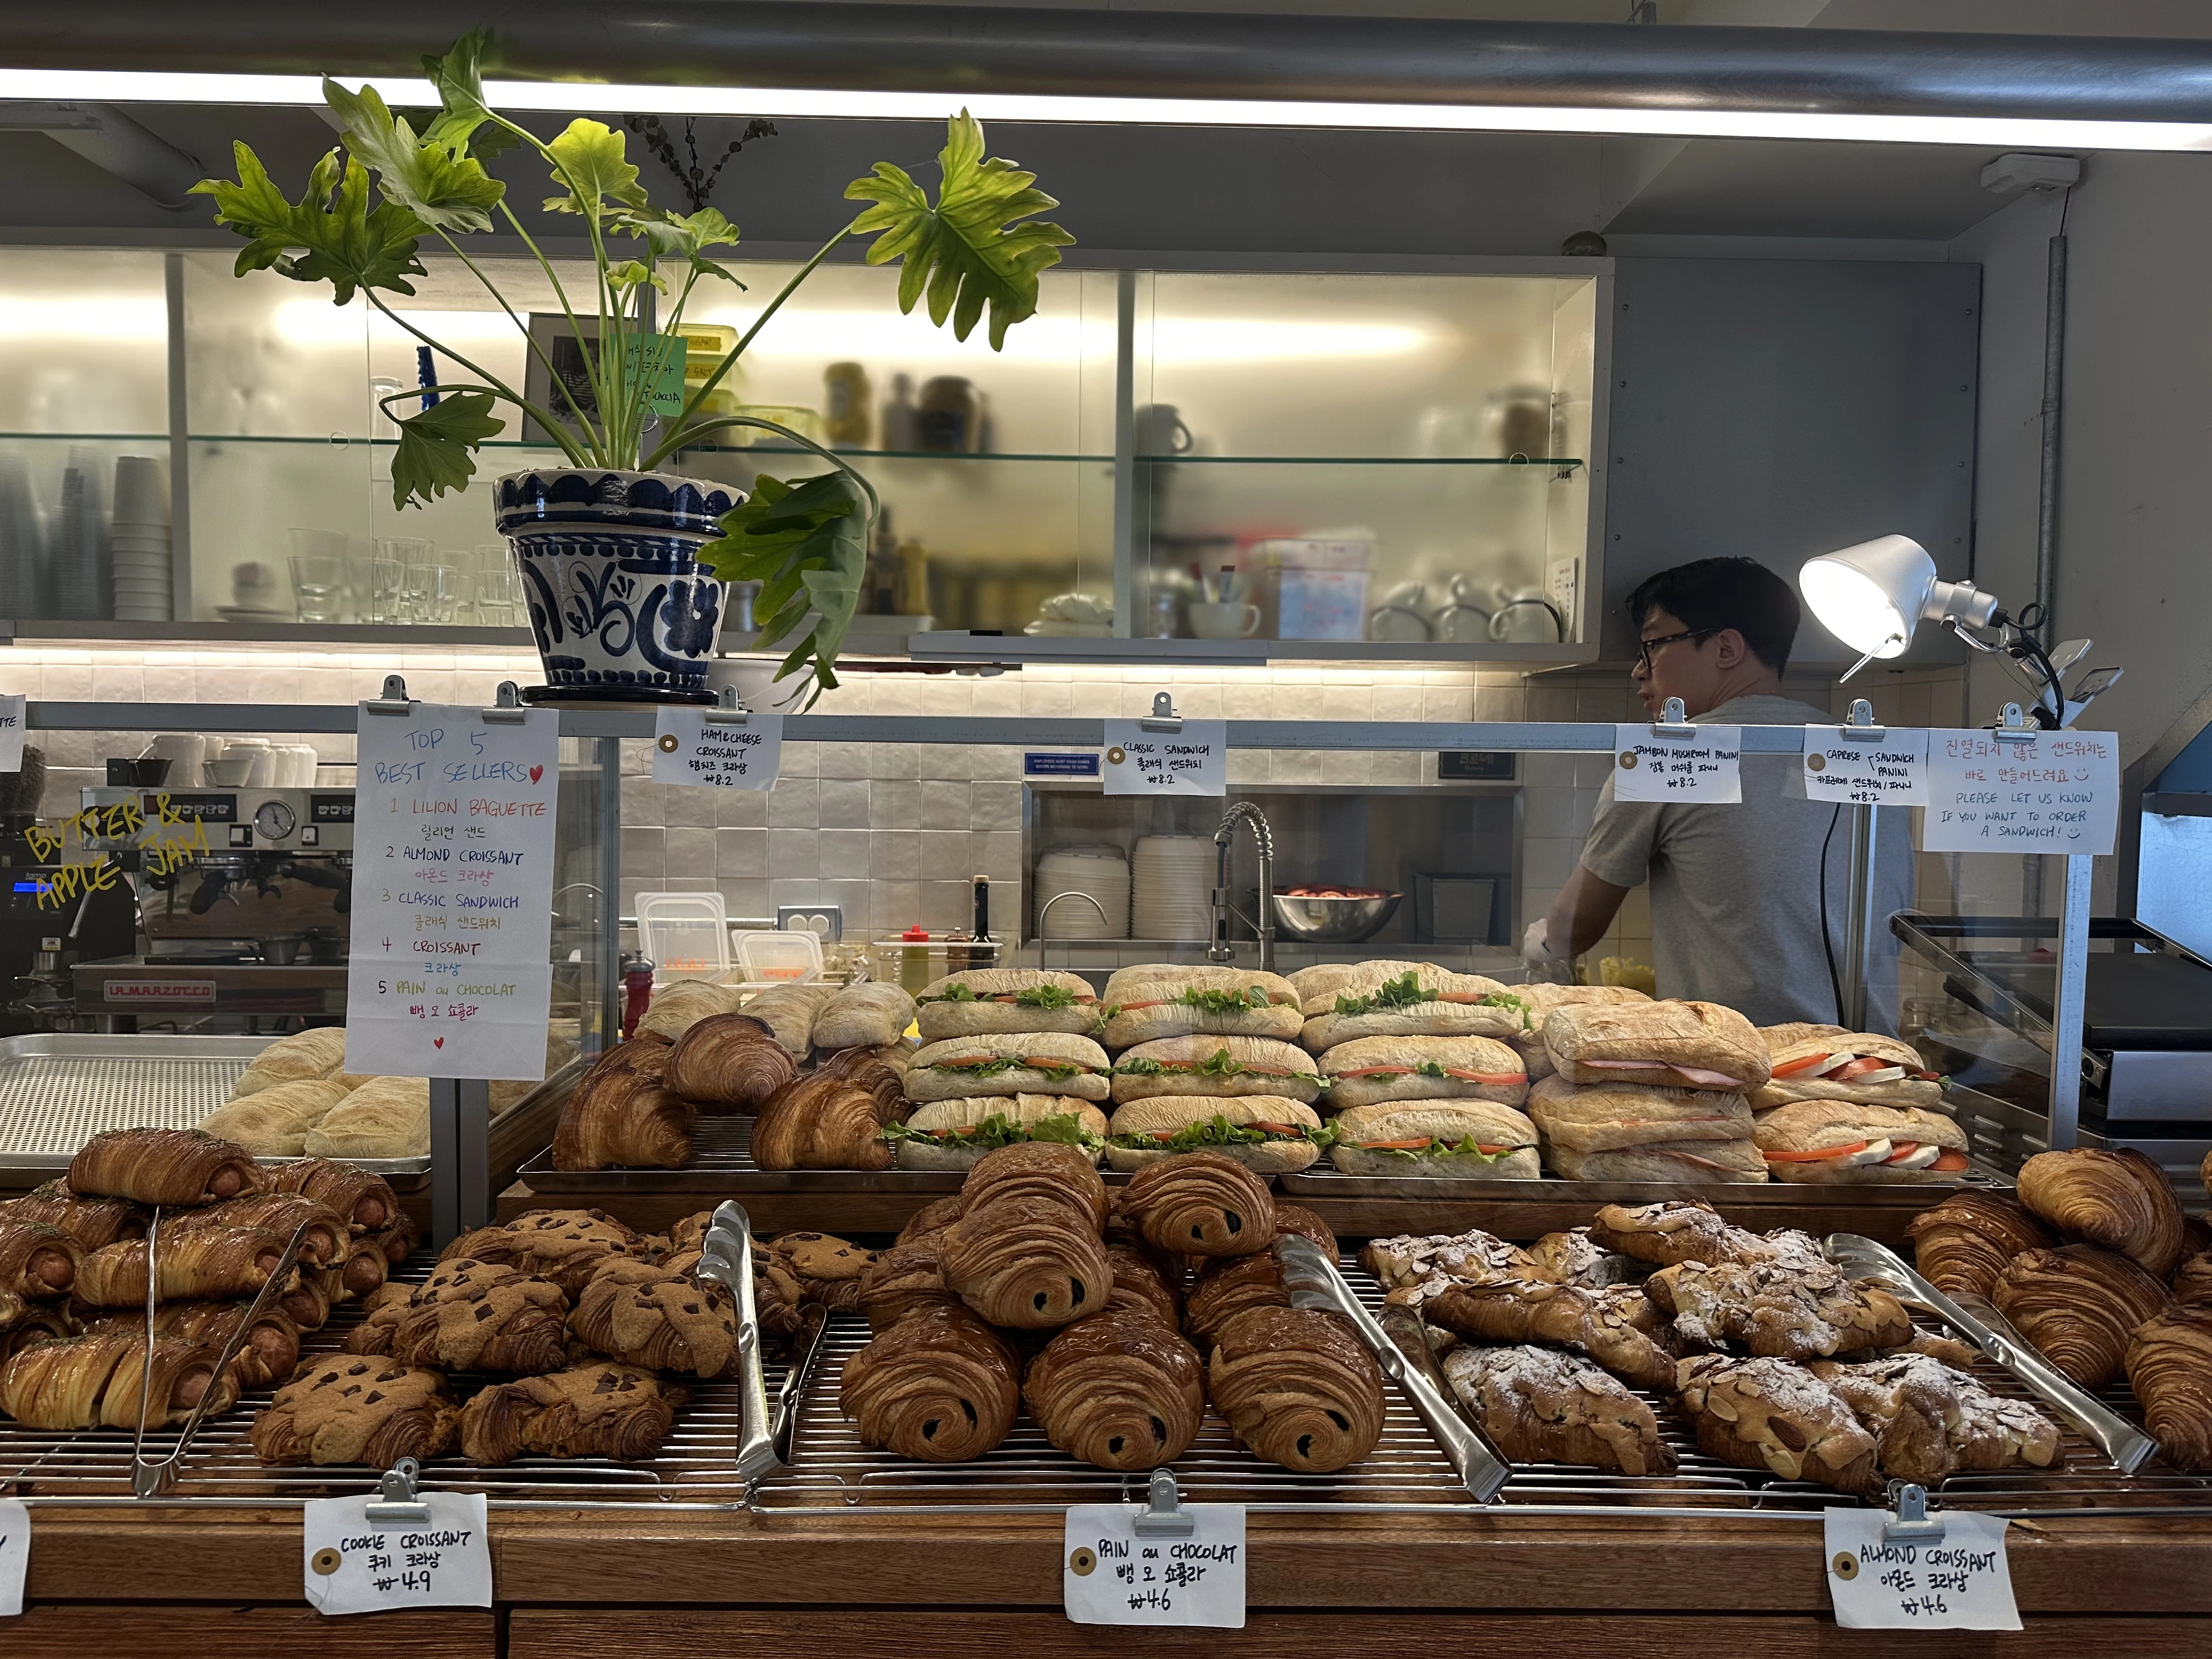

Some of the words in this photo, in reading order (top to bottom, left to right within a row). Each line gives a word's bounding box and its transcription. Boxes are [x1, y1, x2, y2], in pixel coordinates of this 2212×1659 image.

[644, 391, 681, 404] FCACCIA
[404, 729, 444, 751] TOP
[471, 731, 487, 755] 5
[702, 729, 762, 746] HAM&CHEESE
[696, 747, 747, 759] CROISSANT
[1124, 742, 1154, 753] CLASSIC
[1165, 745, 1209, 756] SANDWICH
[1633, 745, 1668, 757] JAMBON
[1672, 748, 1709, 759] MUSHROOM
[1716, 751, 1738, 761] PANINI
[1827, 750, 1860, 761] CAPRESE
[1876, 752, 1914, 763] SANDWICH
[1946, 738, 2000, 759] 진열되지
[2013, 742, 2038, 761] 않은
[2051, 741, 2106, 758] 샌드위치는
[375, 762, 426, 784] BEST
[444, 761, 527, 783] SELLERS
[689, 759, 716, 771] 햄치즈
[723, 763, 747, 775] 크라상
[1137, 757, 1161, 771] 클래식
[1169, 759, 1201, 770] 샌드위치
[1649, 761, 1664, 772] 잠봉
[1671, 761, 1692, 774] 머쉬룸
[1878, 766, 1908, 777] PANINI
[703, 774, 733, 786] ₩8.2
[1147, 774, 1175, 784] ₩8.2
[1667, 777, 1697, 787] ₩8.2
[1966, 769, 1987, 781] 바로
[1999, 768, 2069, 784] 만들어드려요
[1849, 792, 1880, 802] ₩8.2
[1957, 792, 1997, 804] PLEASE
[2012, 793, 2030, 803] LET
[2039, 793, 2052, 804] US
[2060, 792, 2092, 803] KNOW
[391, 798, 398, 812] 1
[414, 799, 456, 814] LILION
[470, 799, 546, 817] BAGUETTE
[1942, 811, 1953, 822] IF
[1959, 812, 1976, 822] YOU
[1985, 812, 2017, 821] WANT
[2027, 812, 2039, 820] TO
[2049, 810, 2086, 822] ORDER
[24, 795, 146, 863] BUTTER
[157, 792, 185, 827] &
[422, 825, 454, 841] 릴리언
[464, 826, 485, 838] 샌드
[1981, 825, 1989, 837] A
[1998, 826, 2061, 838] SANDWICH!
[35, 854, 121, 911] APPLE
[139, 814, 211, 876] JAM
[386, 847, 394, 857] 2
[404, 846, 450, 861] ALMOND
[460, 850, 523, 865] CROISSANT
[415, 868, 448, 883] 아몬드
[457, 869, 494, 887] 크라상
[382, 889, 391, 902] 3
[399, 891, 445, 906] CLASSIC
[456, 894, 518, 909] SANDWICH
[415, 915, 447, 931] 클래식
[458, 916, 500, 930] 샌드위치
[382, 937, 392, 952] 4
[414, 941, 481, 955] CROISSANT
[425, 962, 461, 977] 크라상
[379, 981, 386, 994] 5
[397, 980, 425, 995] PAIN
[436, 987, 448, 996] au
[457, 983, 516, 997] CHOCOLAT
[410, 1005, 425, 1019] 뺑
[431, 1006, 439, 1017] 오
[448, 1003, 478, 1021] 쇼콜라
[341, 1535, 385, 1552] COOKIE
[400, 1530, 471, 1549] CROISSANT
[1099, 1539, 1128, 1558] PAIN
[1142, 1548, 1159, 1559] au
[1170, 1543, 1238, 1564] CHOCOLAT
[1860, 1544, 1916, 1564] ALMOND
[1926, 1549, 1996, 1572] CROISSANT
[368, 1554, 391, 1572] 쿠키
[406, 1551, 441, 1568] 크라상
[373, 1571, 430, 1592] ₩4.9
[1116, 1562, 1134, 1584] 뺑
[1143, 1566, 1156, 1581] 오
[1165, 1562, 1206, 1587] 쇼콜라
[1881, 1569, 1915, 1592] 아몬드
[1928, 1570, 1968, 1592] 크라상
[1127, 1588, 1171, 1611] ₩4.6
[1900, 1594, 1947, 1616] ₩4.6
